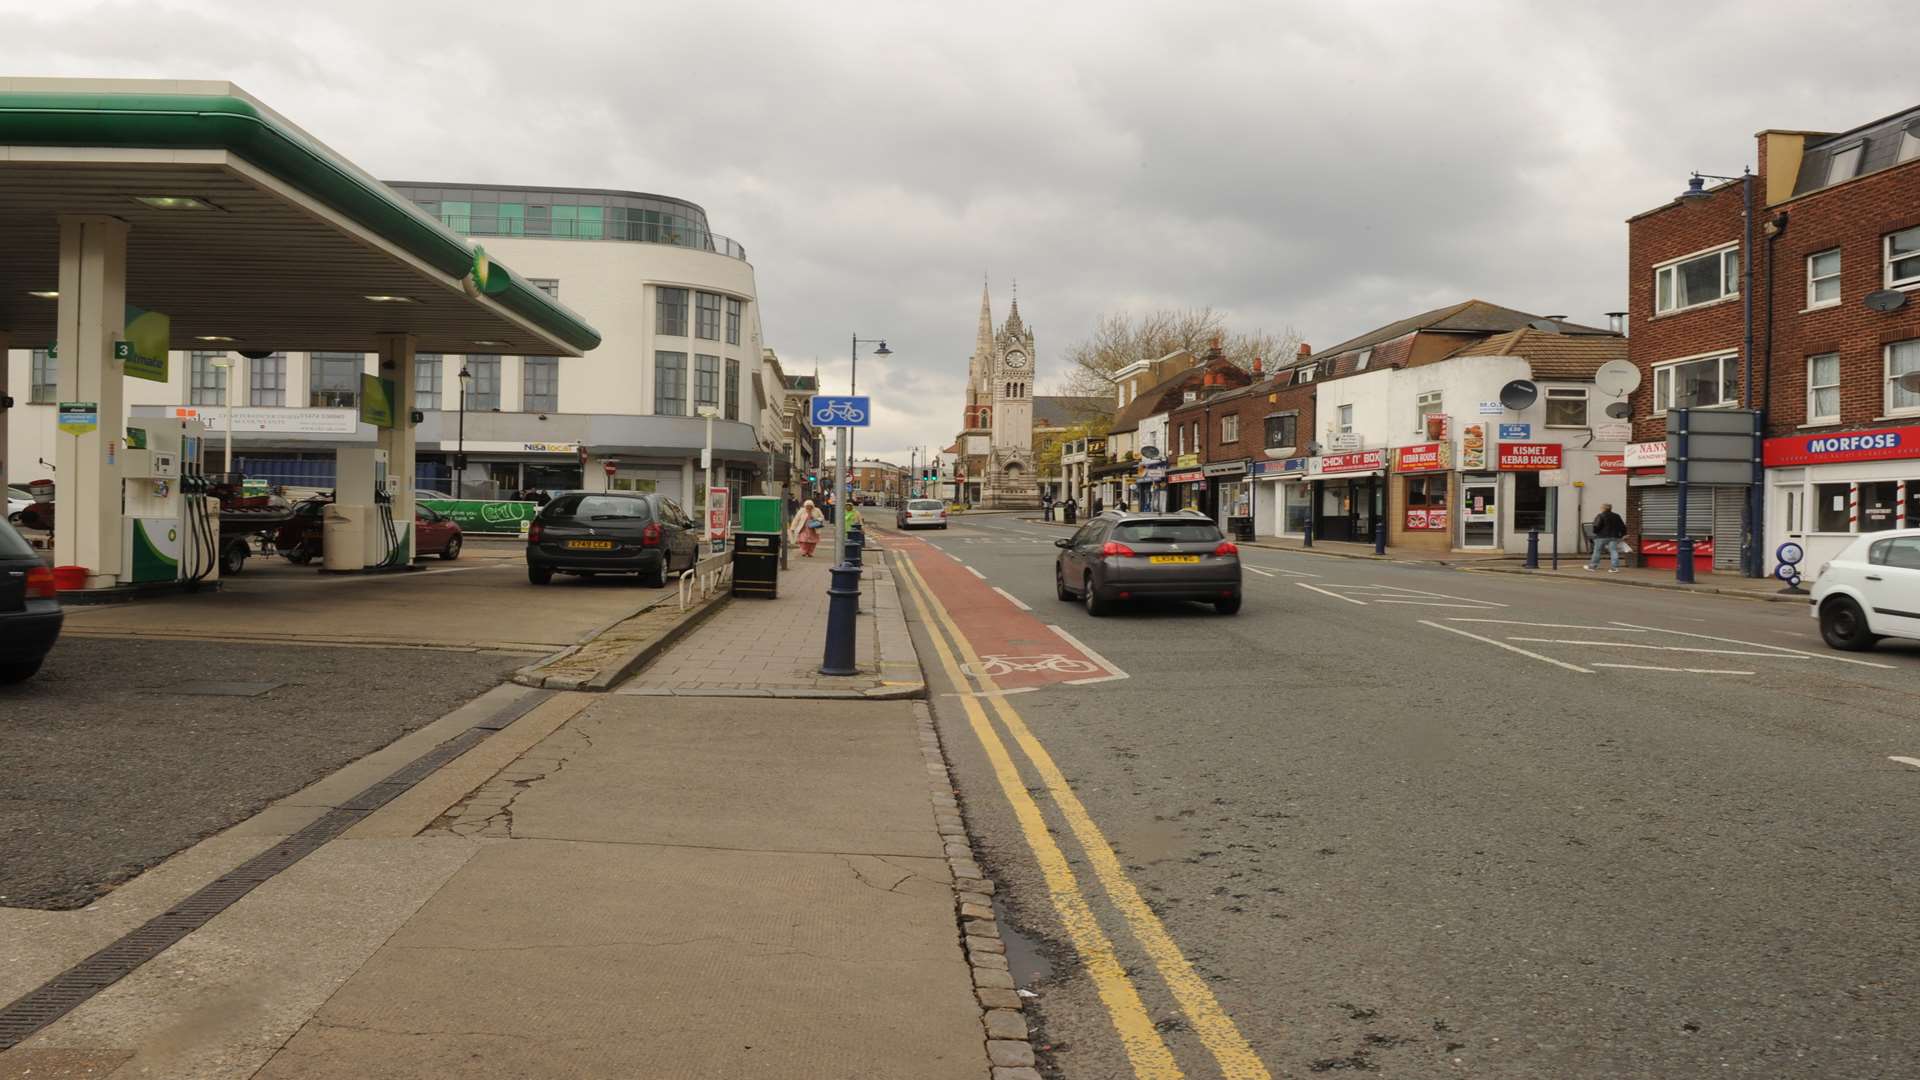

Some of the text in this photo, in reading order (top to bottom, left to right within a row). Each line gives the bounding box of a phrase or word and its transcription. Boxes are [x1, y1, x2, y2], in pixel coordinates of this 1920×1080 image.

[119, 345, 128, 356] 3
[1811, 433, 1895, 453] MORFOSE
[1513, 446, 1547, 455] KISMET
[1363, 452, 1382, 463] BOX
[1501, 456, 1559, 464] KEBAB HOUSE
